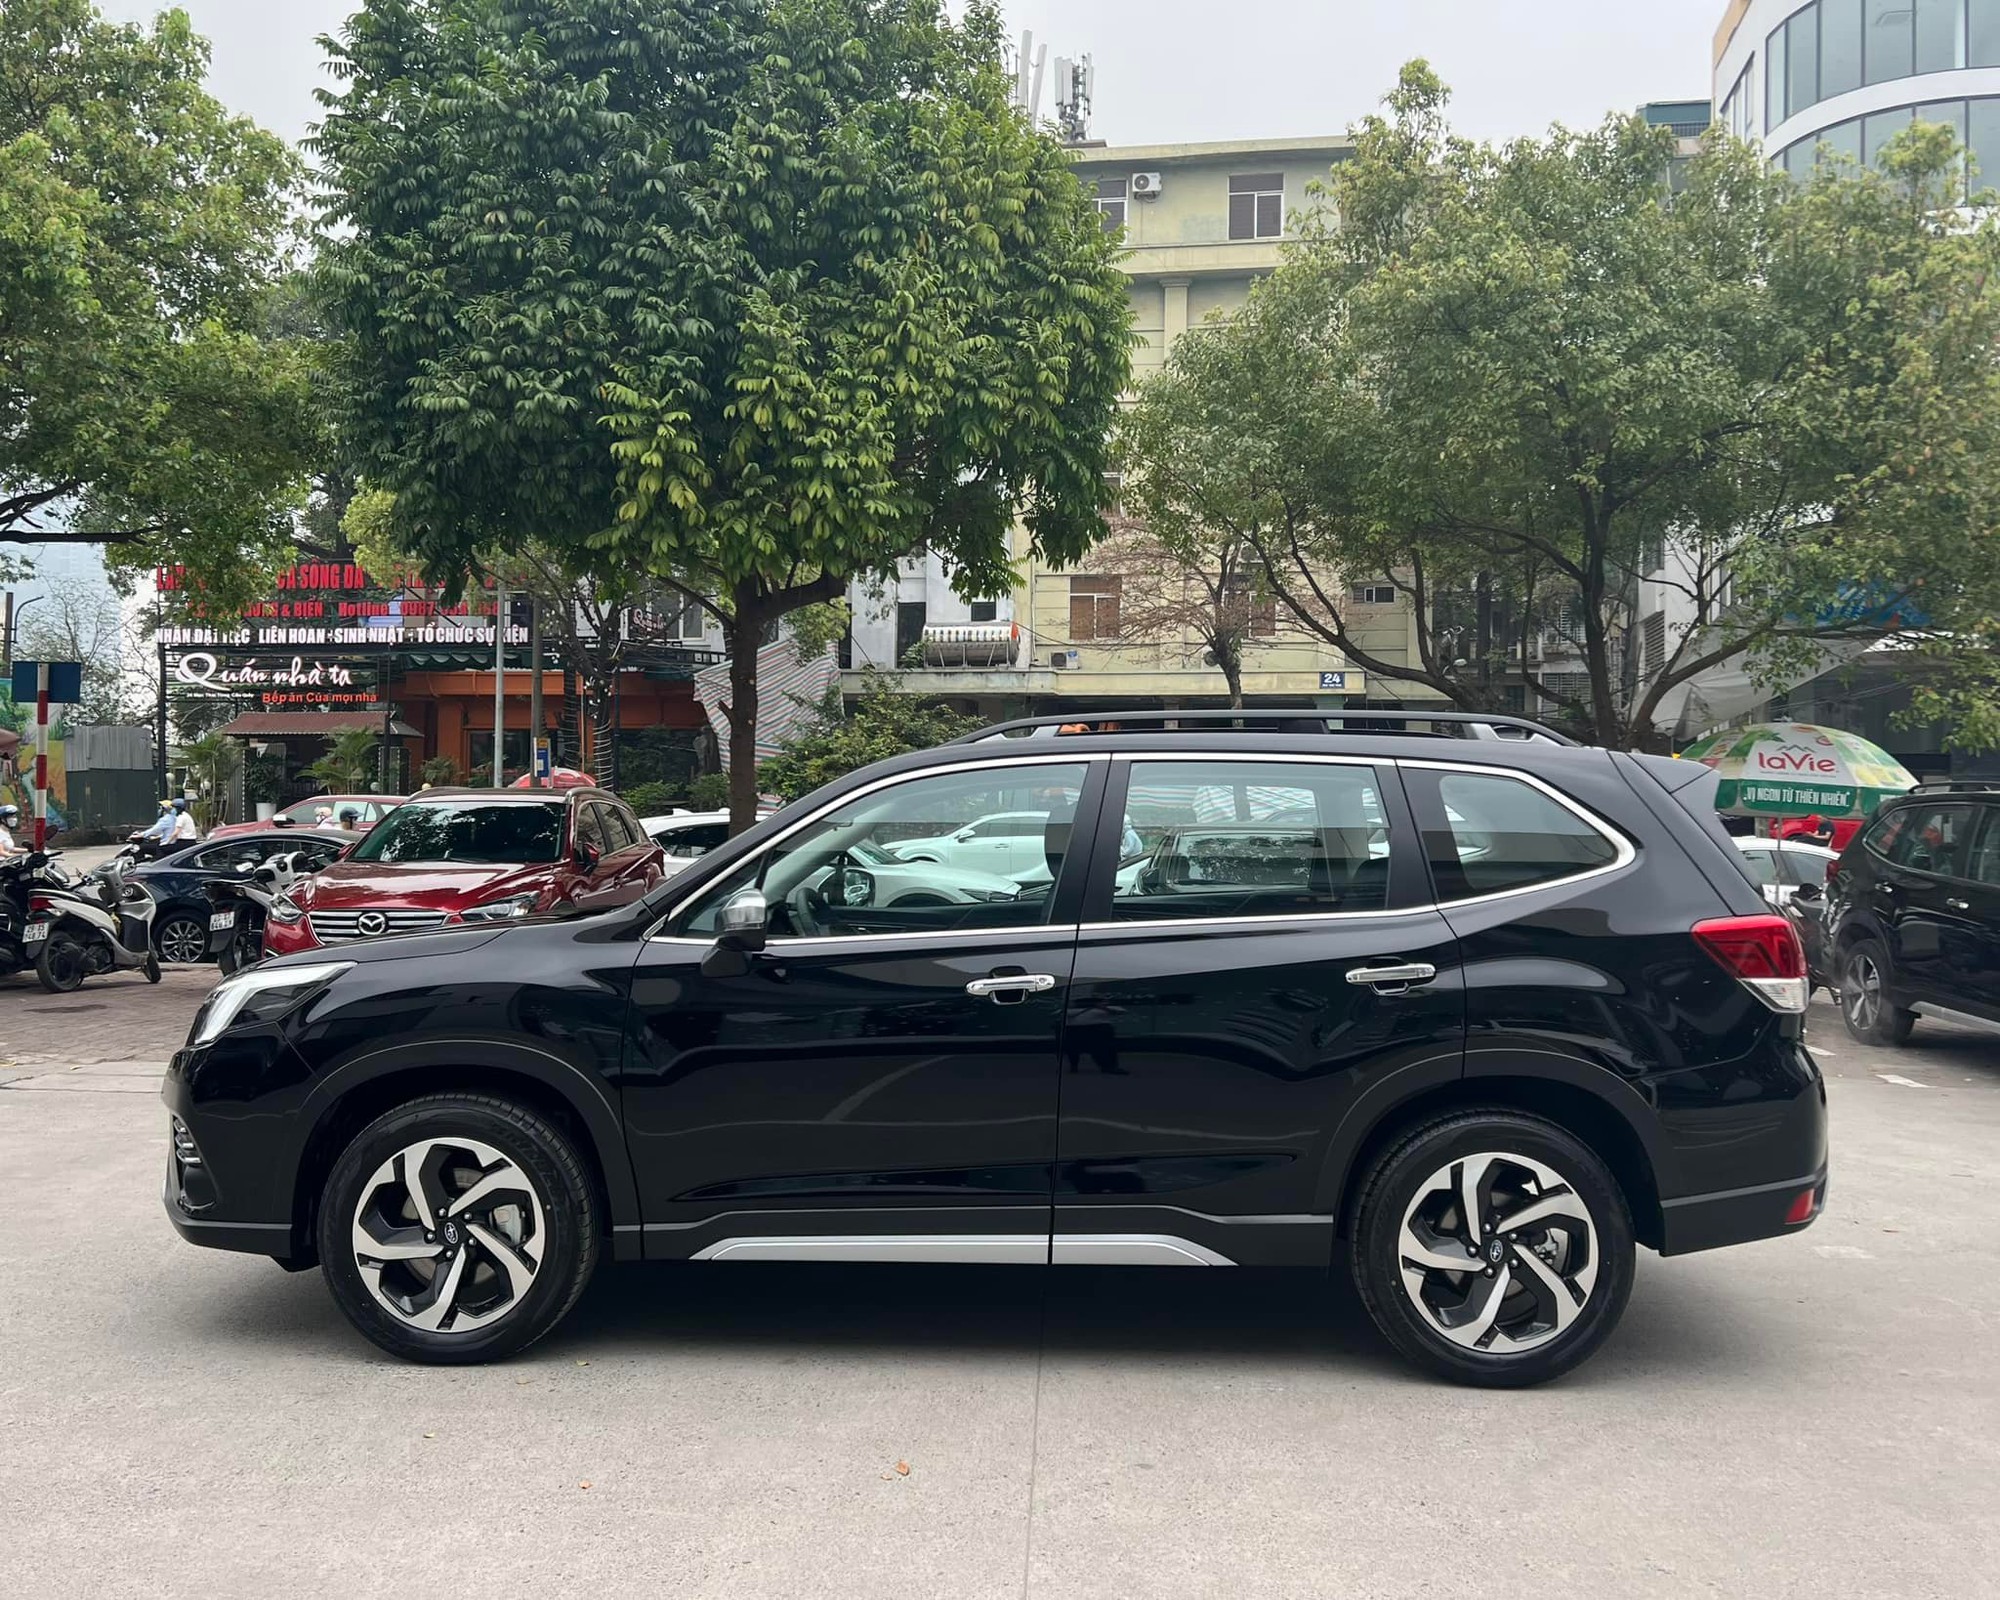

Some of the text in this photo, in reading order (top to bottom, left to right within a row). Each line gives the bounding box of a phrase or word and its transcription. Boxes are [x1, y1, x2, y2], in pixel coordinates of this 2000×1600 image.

[300, 556, 340, 589] SÔNG
[338, 602, 390, 617] Hotline
[259, 626, 286, 644] LIÊN
[289, 629, 325, 643] HOAN
[334, 628, 366, 643] SINH
[368, 627, 404, 645] NHẬT
[417, 622, 436, 643] TỔ
[438, 623, 476, 643] CHỨC
[175, 652, 353, 691] Quán nhà ta
[1324, 673, 1341, 683] 24
